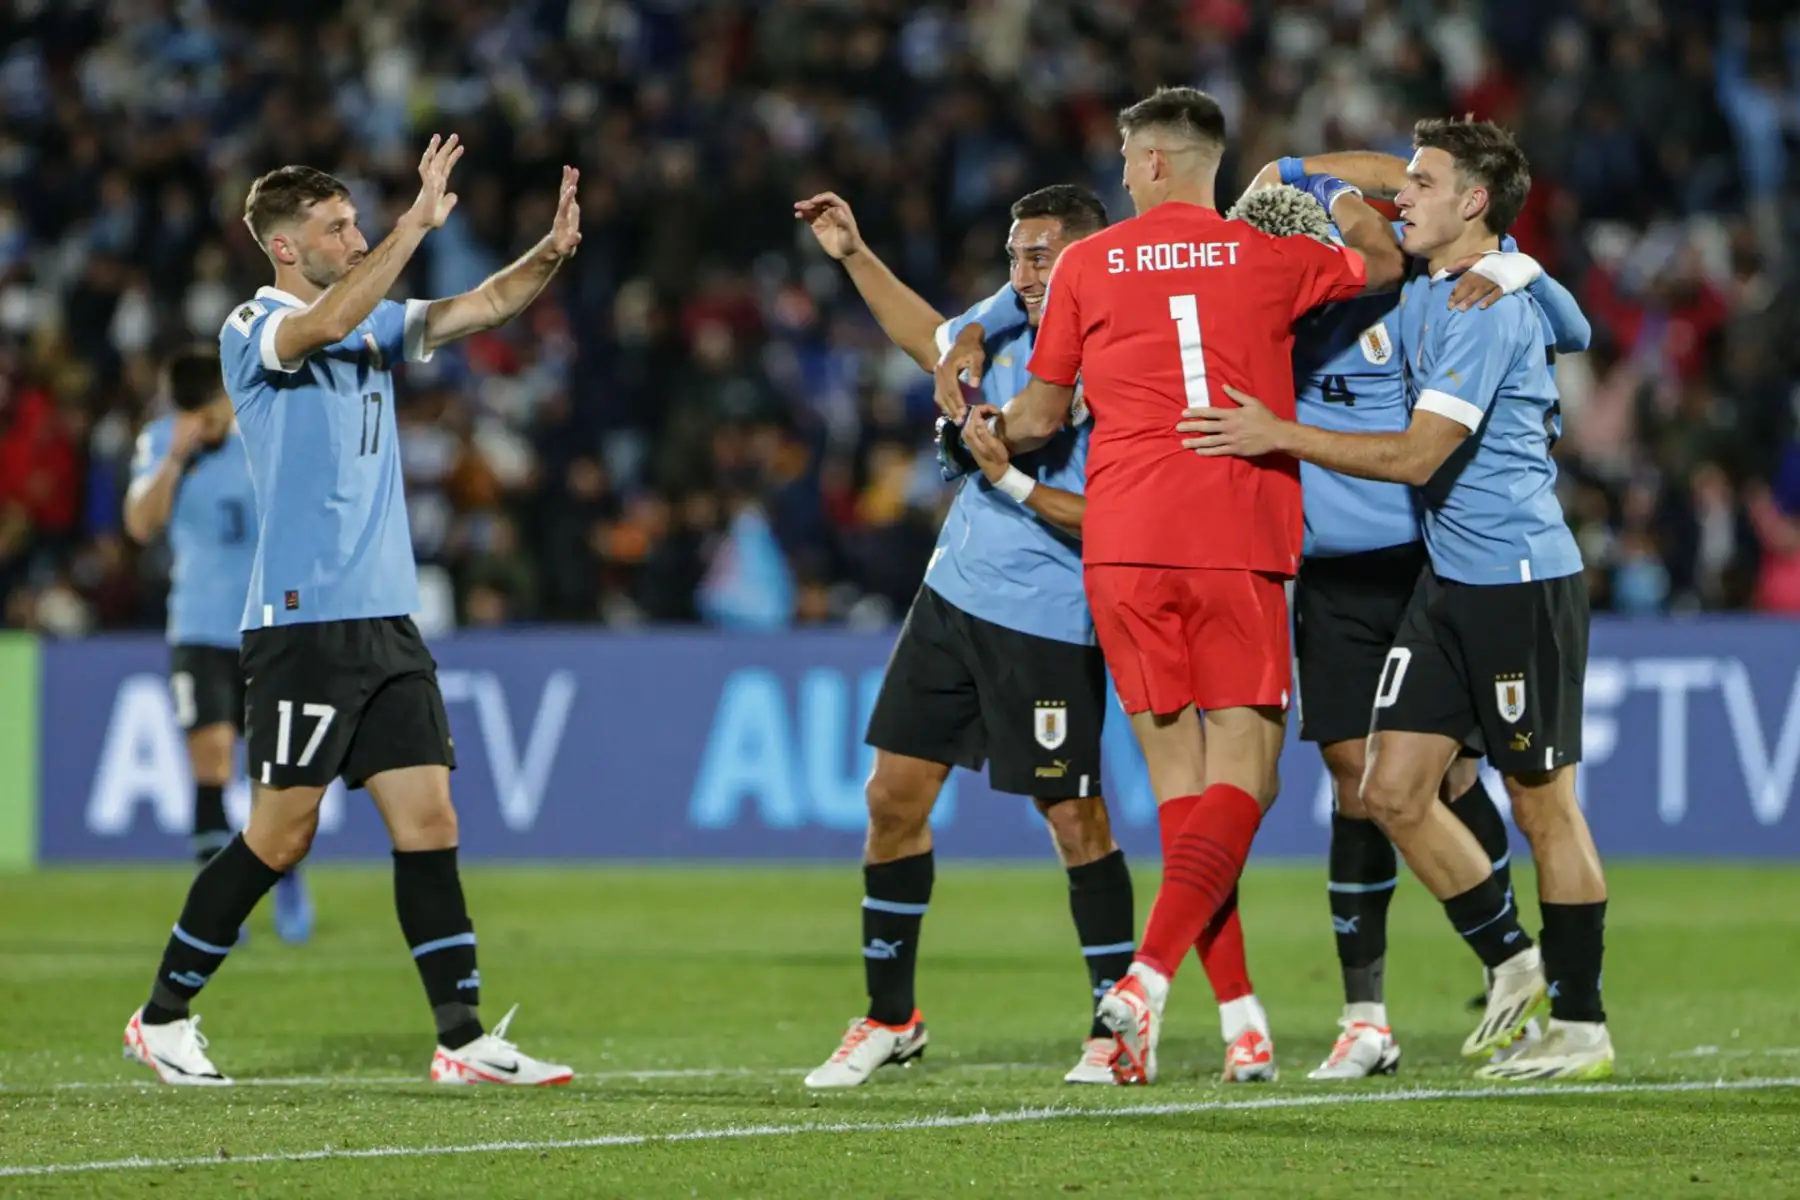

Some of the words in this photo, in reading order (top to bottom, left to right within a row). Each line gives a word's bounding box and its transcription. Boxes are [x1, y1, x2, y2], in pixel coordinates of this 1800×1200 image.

[1108, 248, 1130, 274] S.
[1136, 242, 1240, 272] ROCHET
[1169, 294, 1211, 408] 1
[1321, 374, 1355, 407] 4
[360, 391, 383, 456] 17
[275, 700, 338, 767] 17
